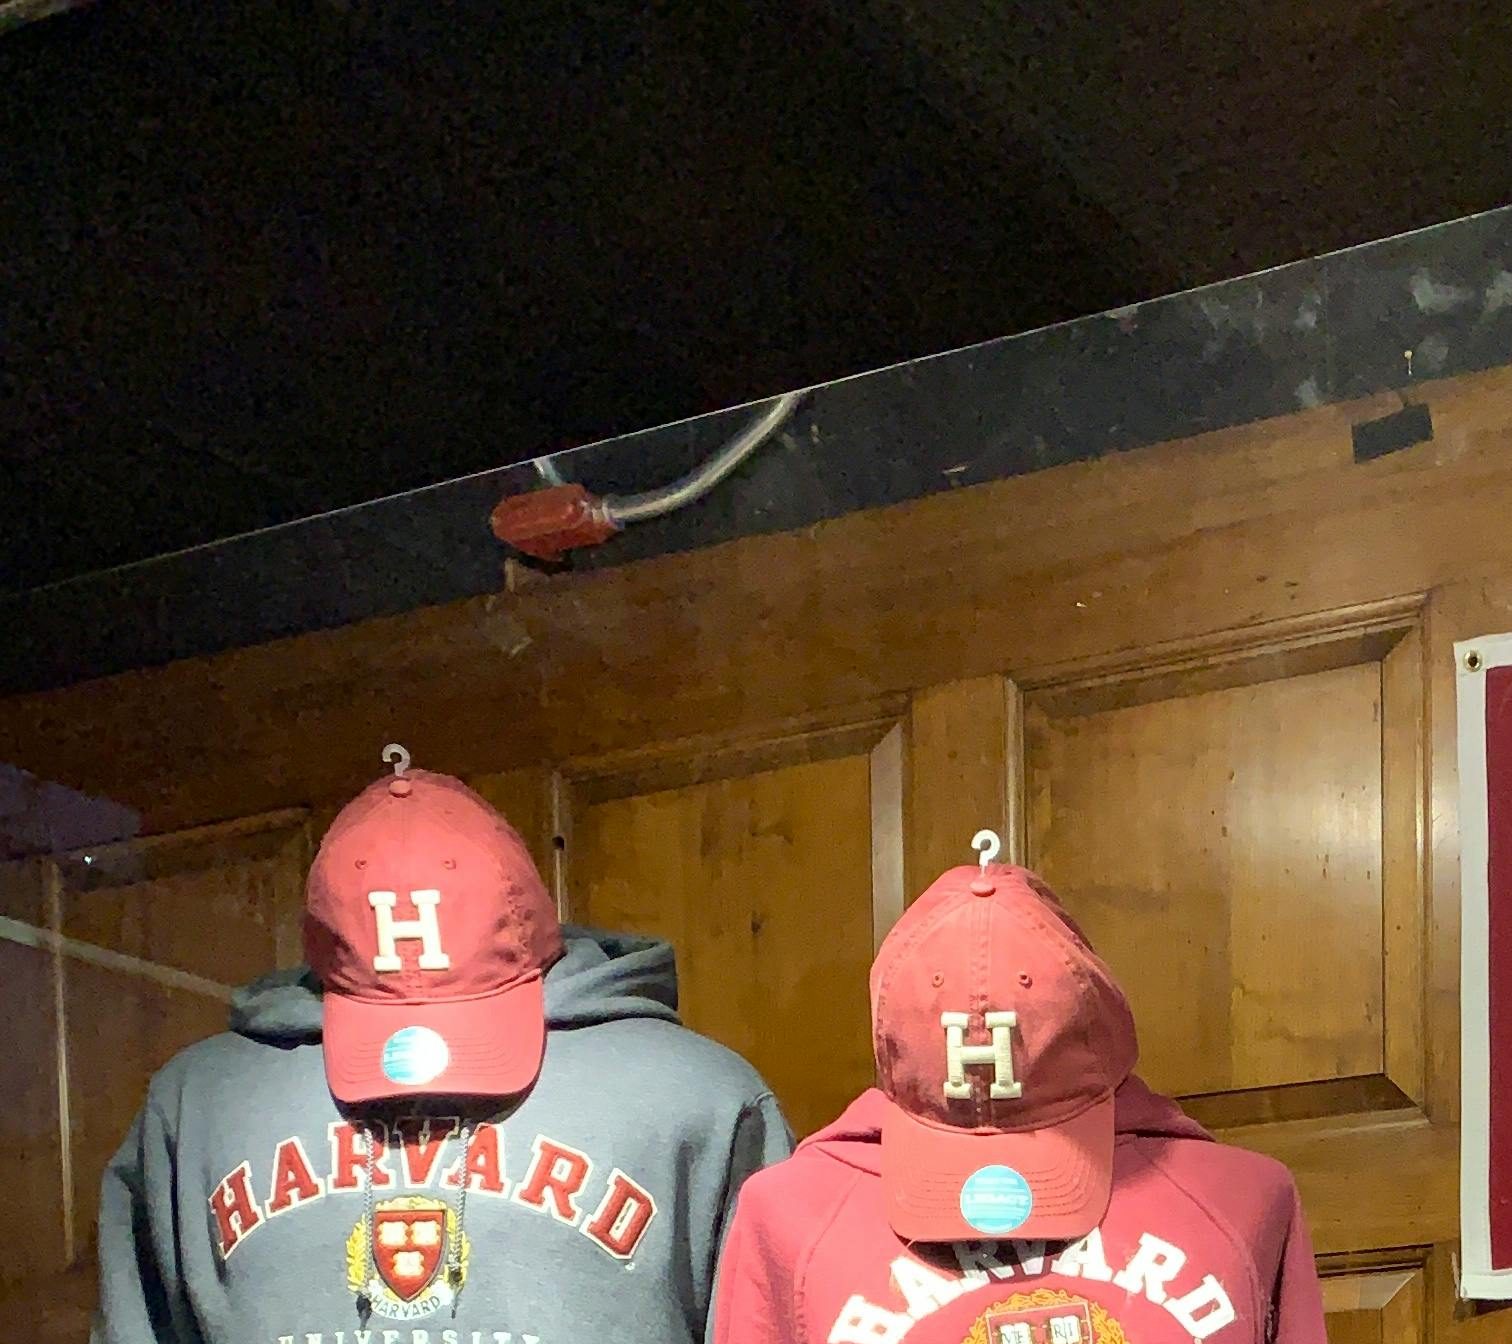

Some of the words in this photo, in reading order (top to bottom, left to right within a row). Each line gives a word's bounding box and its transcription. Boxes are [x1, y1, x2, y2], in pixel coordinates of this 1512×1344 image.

[369, 890, 449, 970] H
[941, 1011, 1022, 1098] H
[208, 1117, 657, 1260] HARVARD
[372, 1295, 441, 1318] HARVARD
